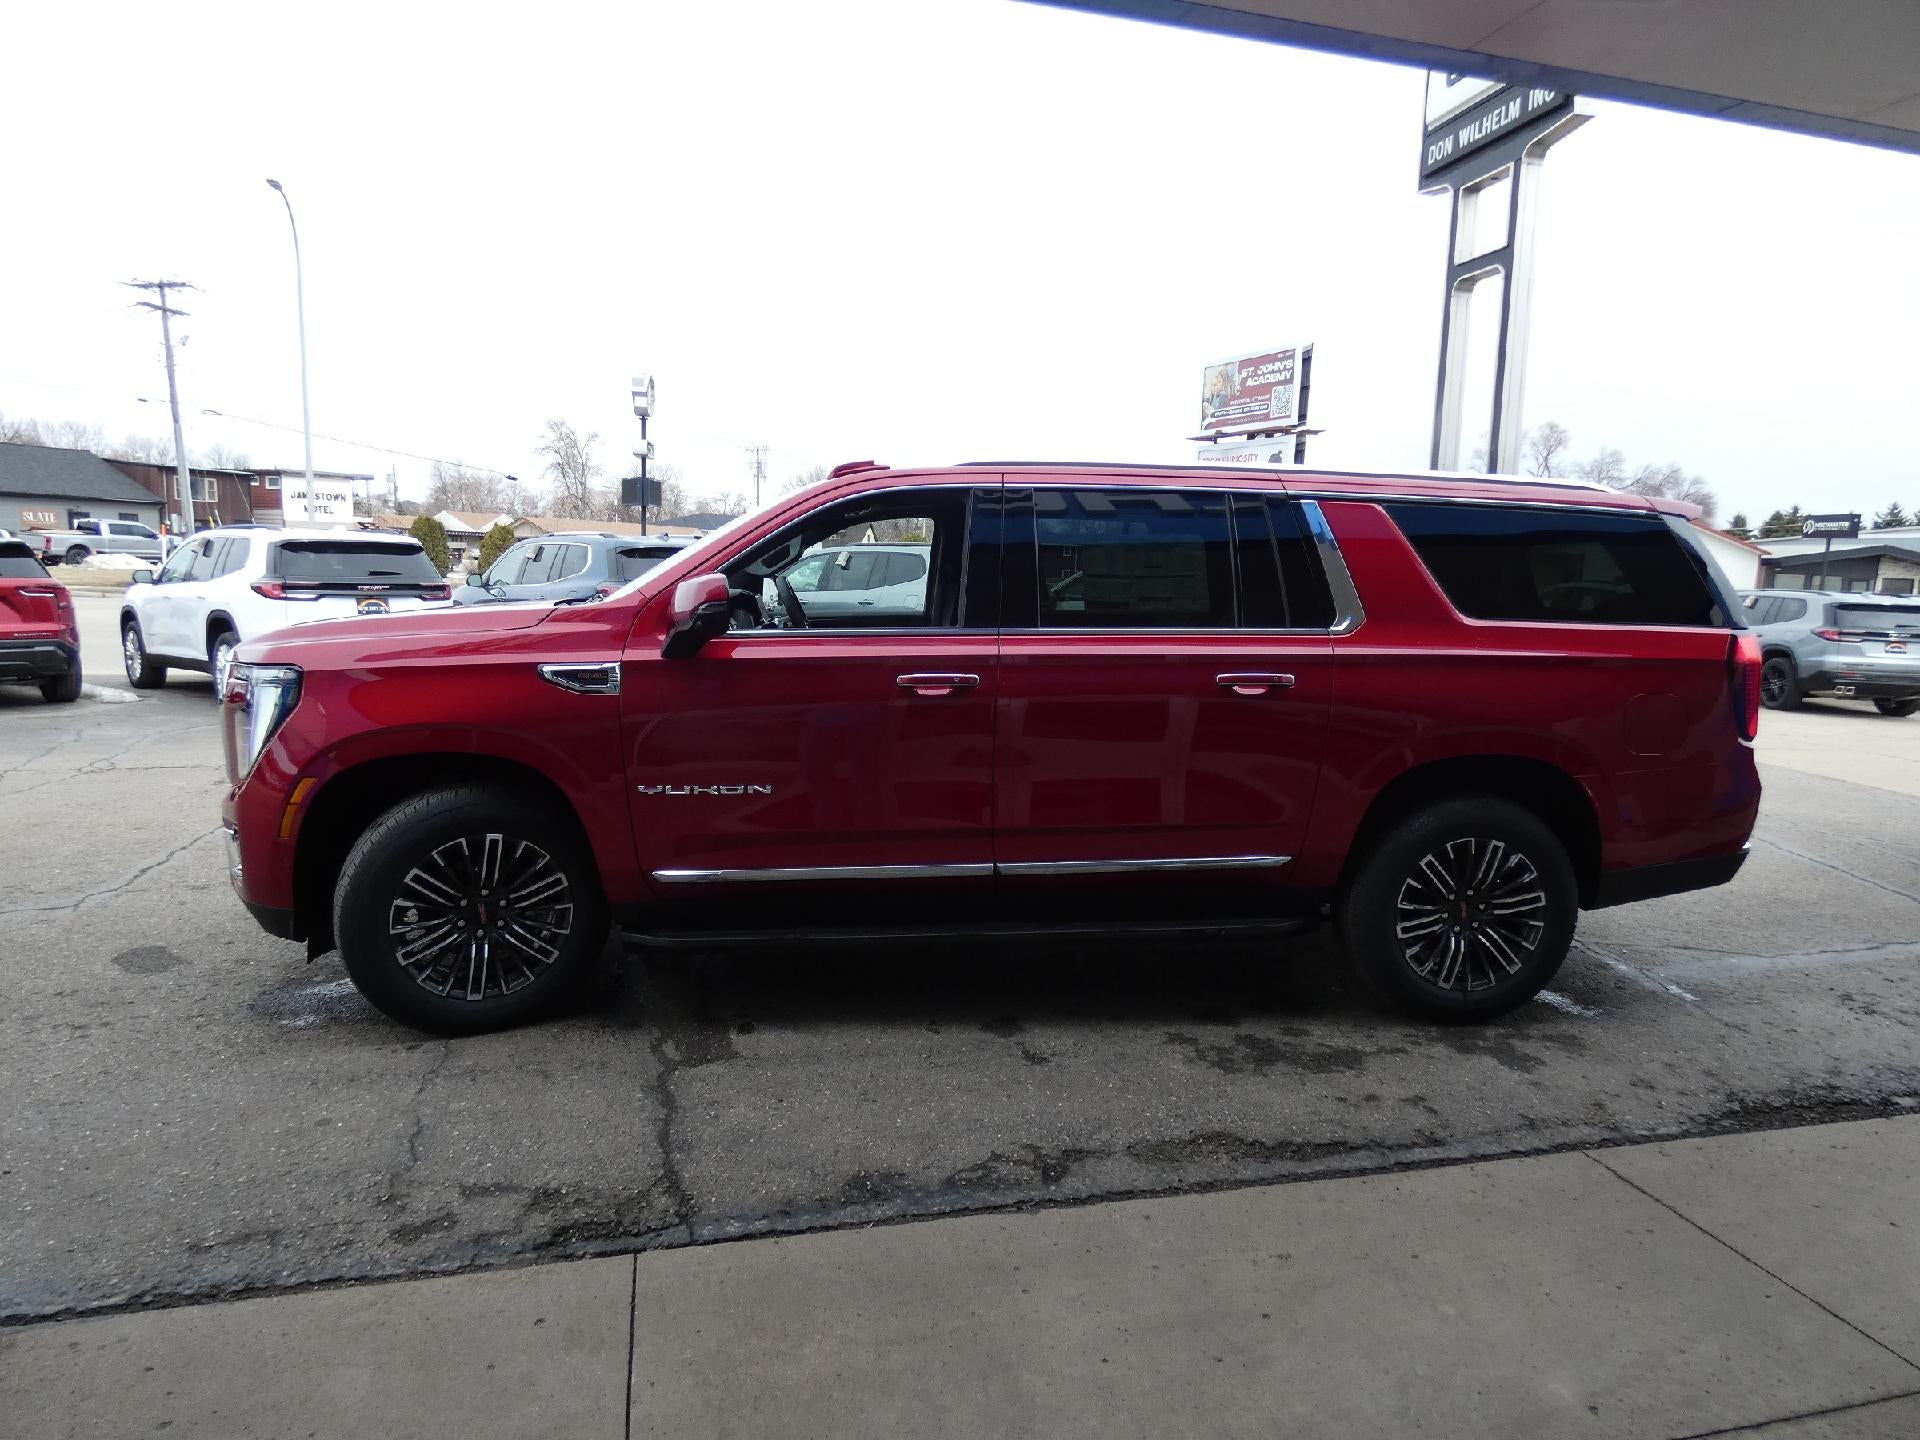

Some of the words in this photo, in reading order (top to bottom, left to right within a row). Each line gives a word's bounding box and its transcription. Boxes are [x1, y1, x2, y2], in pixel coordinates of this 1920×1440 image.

[1427, 136, 1453, 166] DON
[1459, 97, 1523, 149] WILHELM
[1257, 360, 1294, 375] JOHN'S
[1246, 370, 1293, 387] ACADEMY
[290, 491, 347, 502] JAMSTOWN
[22, 511, 58, 522] SLATE
[637, 784, 772, 795] YUKON
